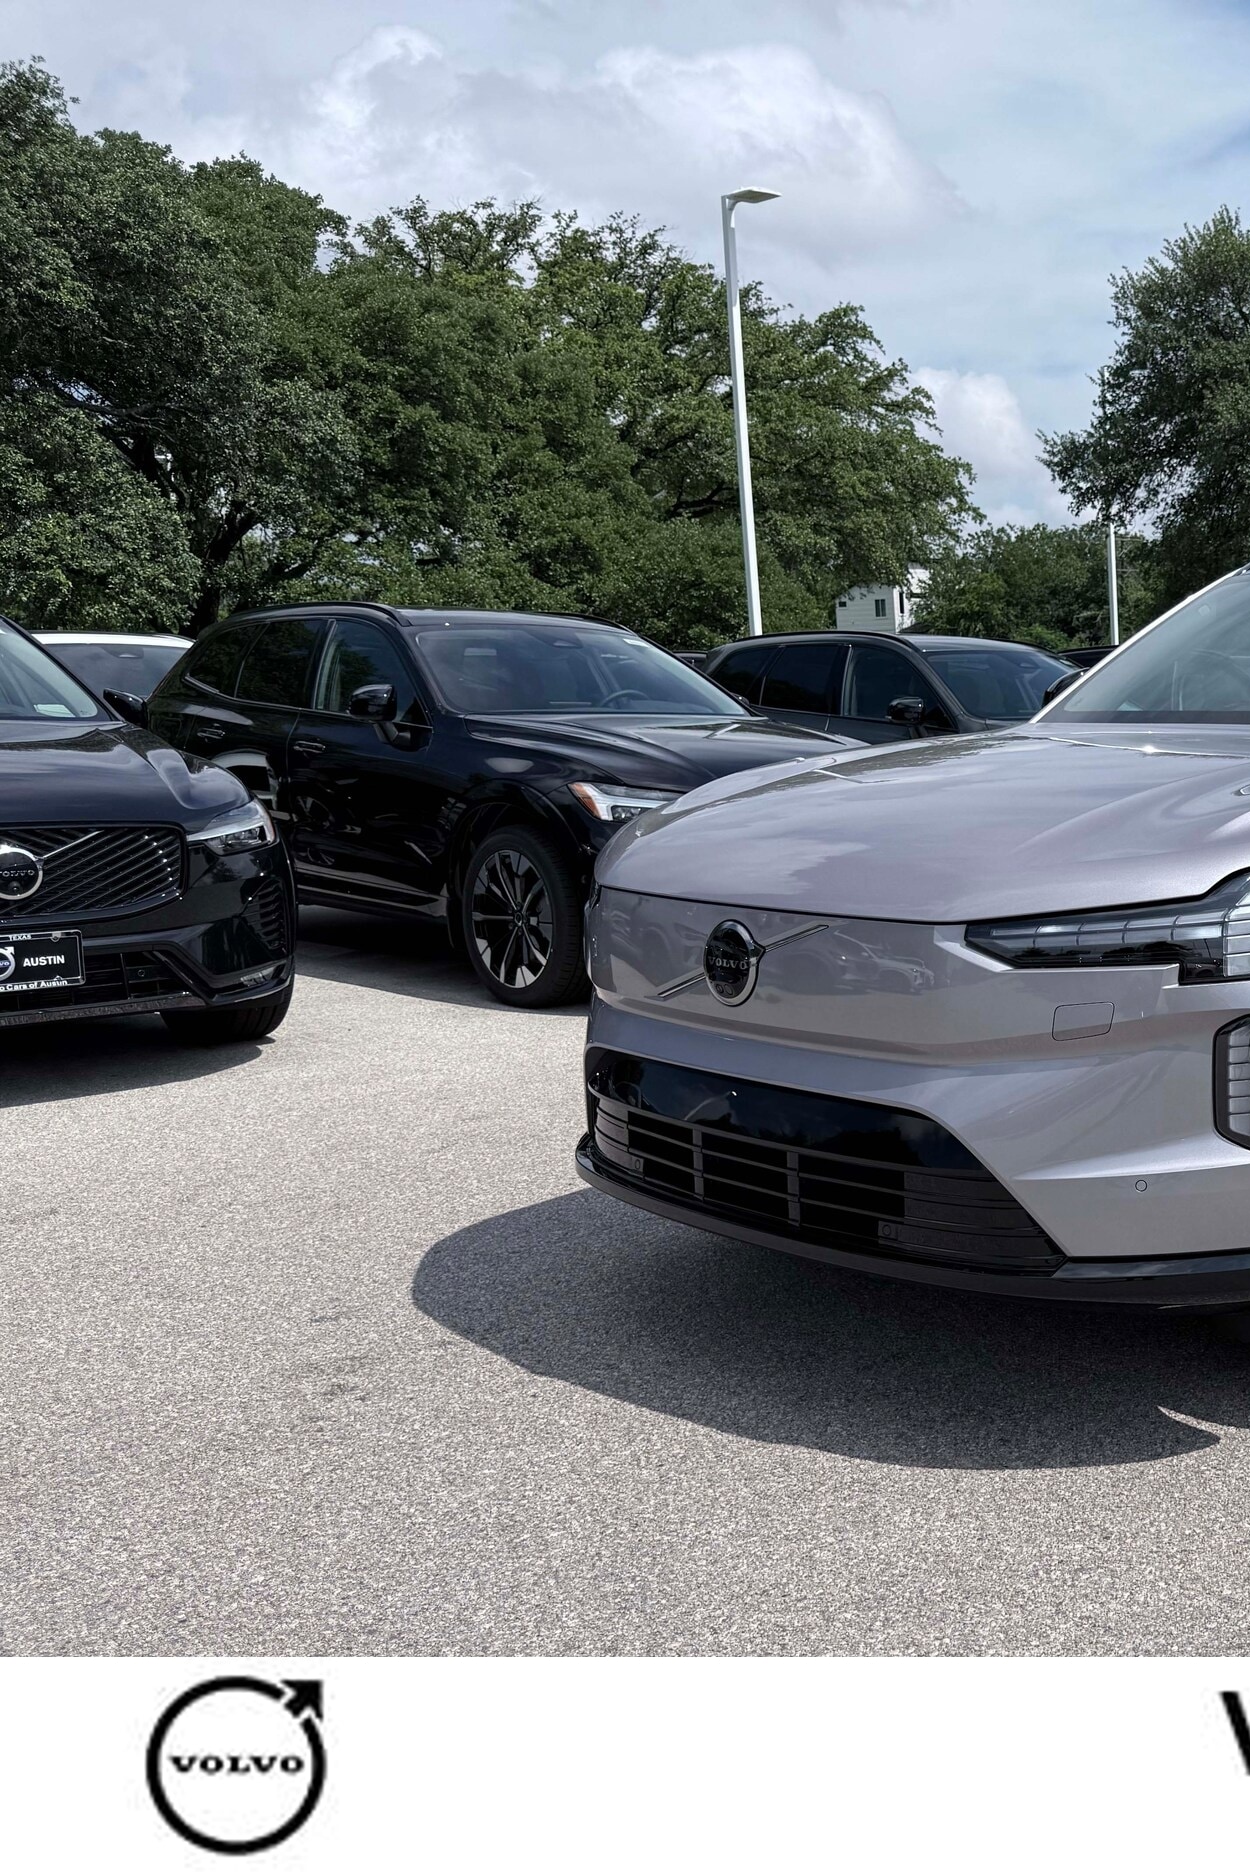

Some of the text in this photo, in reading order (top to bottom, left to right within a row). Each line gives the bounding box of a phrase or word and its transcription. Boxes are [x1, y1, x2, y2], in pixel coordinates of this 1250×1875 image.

[9, 933, 32, 942] TEXAS
[23, 955, 65, 967] AUSTIN
[707, 956, 749, 970] VOLVO
[6, 983, 28, 991] Cars
